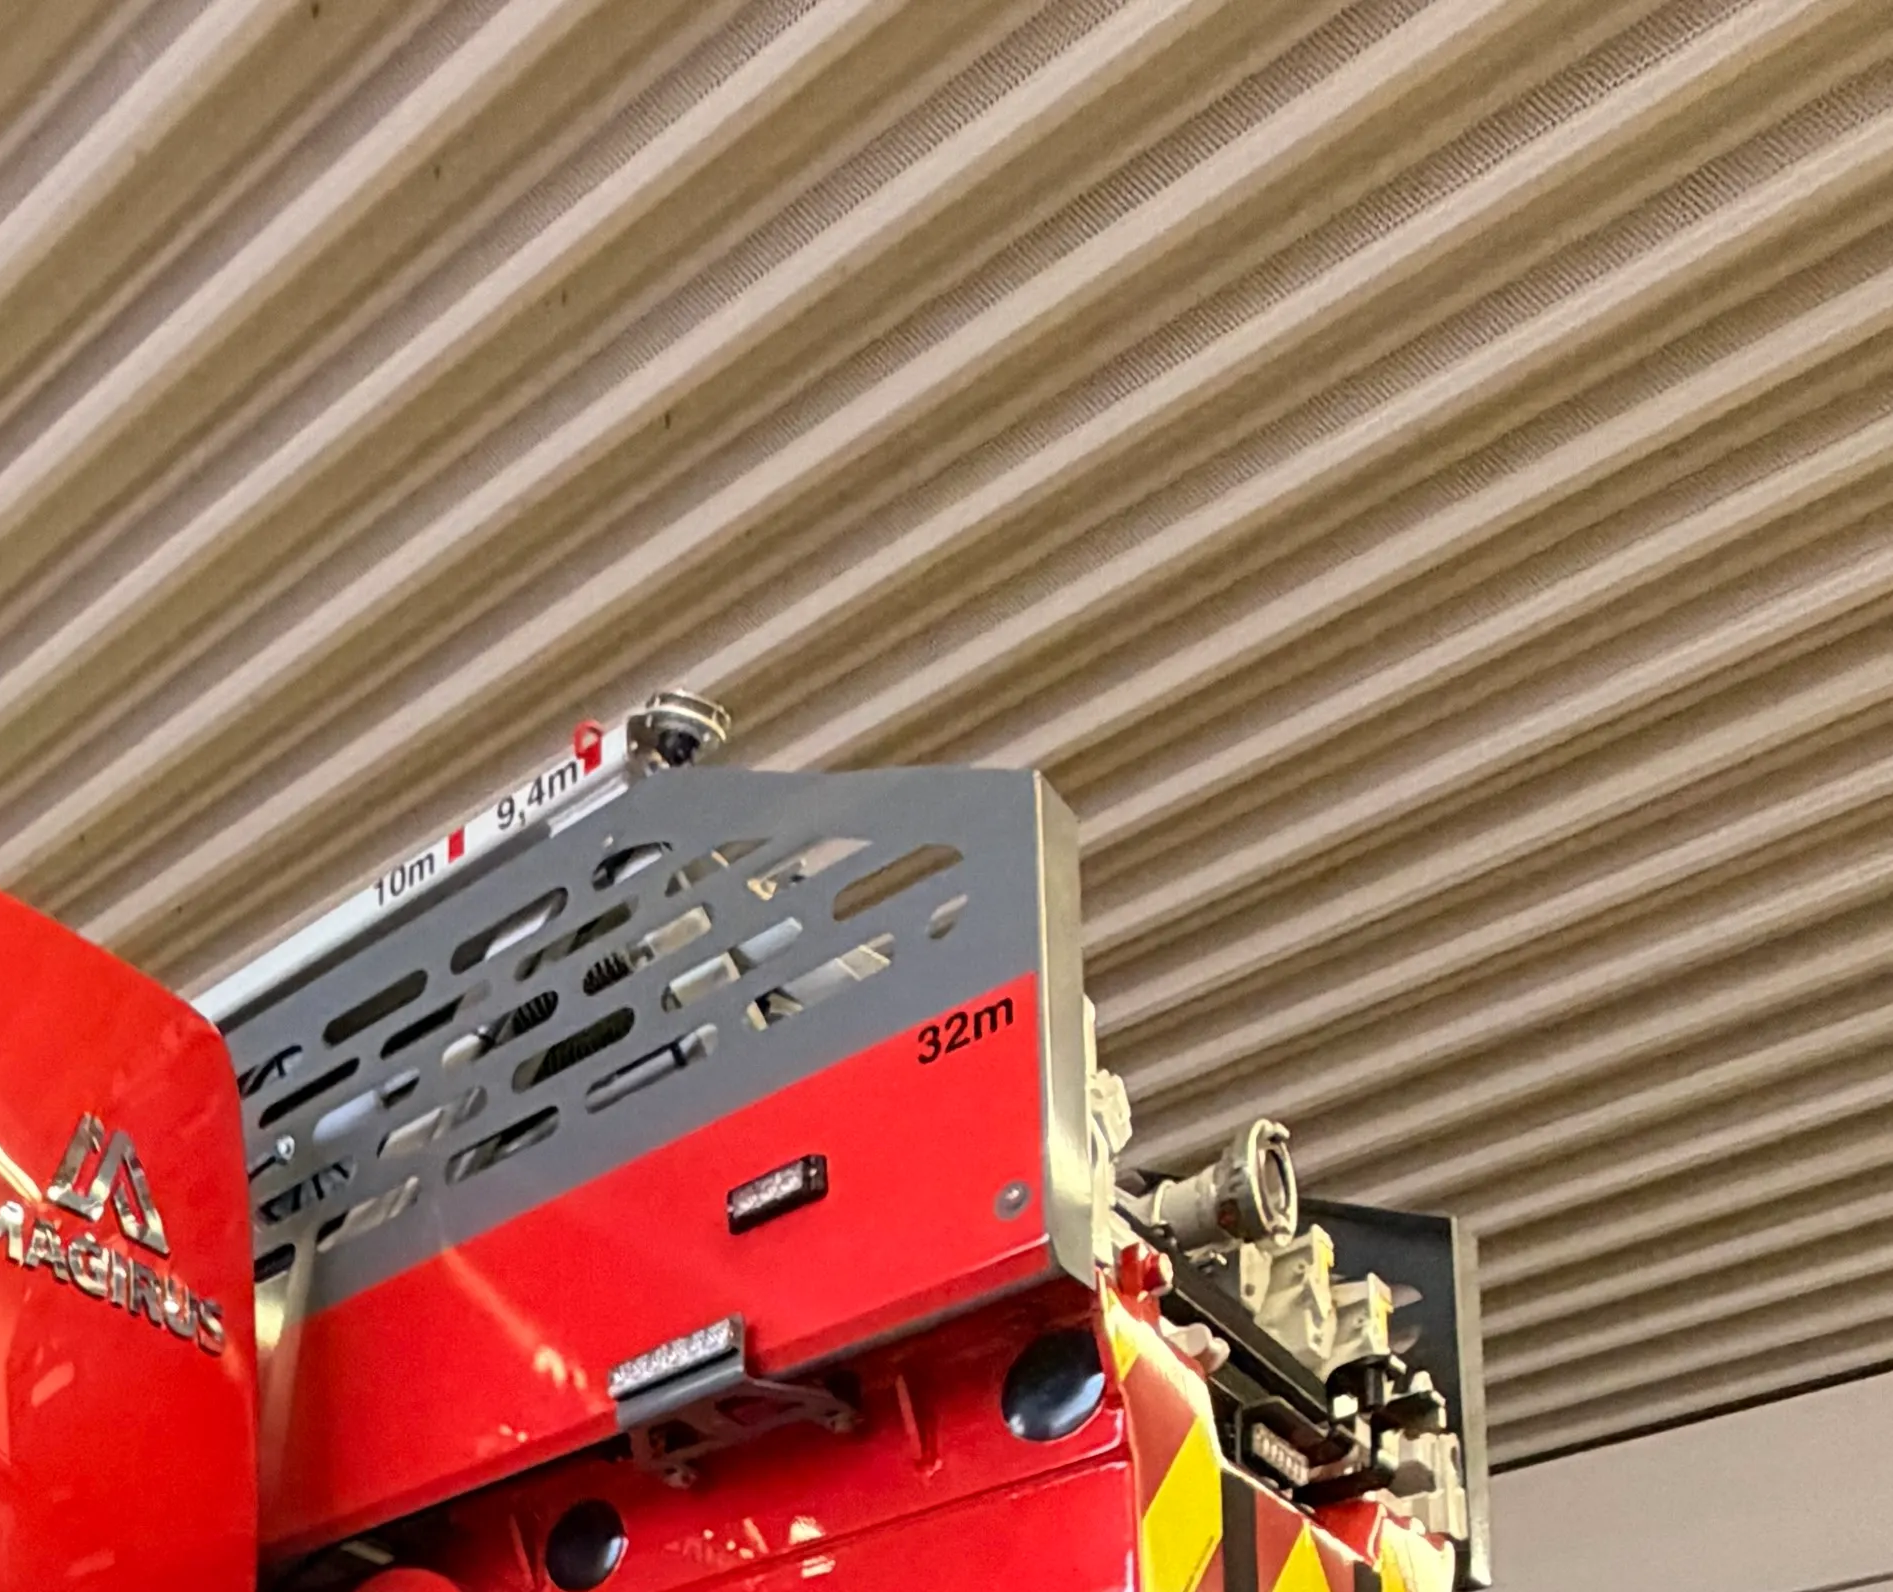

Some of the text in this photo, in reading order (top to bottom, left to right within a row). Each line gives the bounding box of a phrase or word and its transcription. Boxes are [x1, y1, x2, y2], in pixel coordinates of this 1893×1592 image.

[497, 760, 579, 830] 9,4m
[375, 852, 435, 906] 10m
[917, 997, 1014, 1065] 32m
